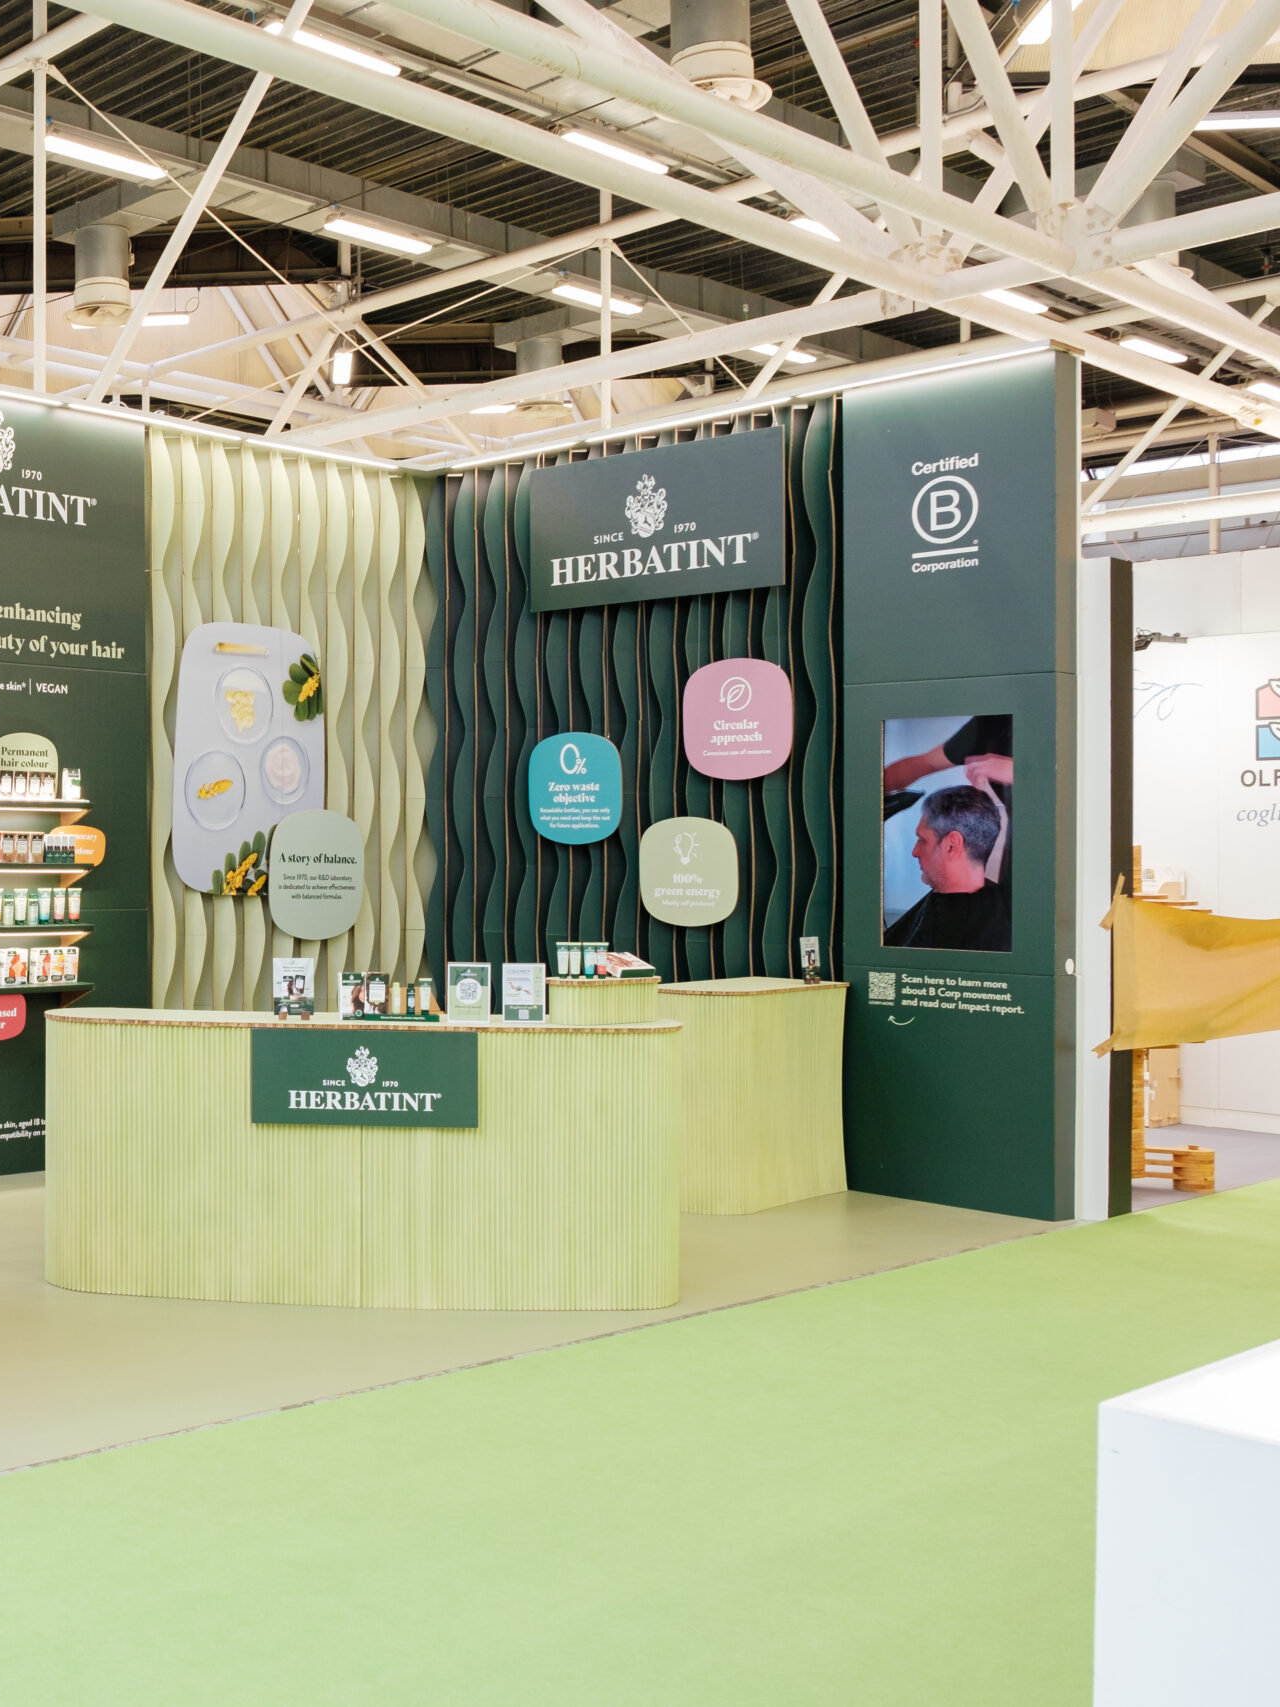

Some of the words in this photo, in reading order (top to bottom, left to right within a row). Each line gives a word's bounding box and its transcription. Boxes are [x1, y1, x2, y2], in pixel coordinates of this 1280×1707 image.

[911, 453, 979, 476] Certified
[21, 468, 42, 481] 1970
[930, 489, 962, 532] B
[593, 531, 624, 545] SINCE
[673, 521, 697, 534] 1970
[912, 557, 979, 573] Corporation
[28, 635, 48, 653] of
[50, 641, 89, 658] your
[91, 640, 125, 660] hair
[35, 682, 69, 694] VEGAN
[713, 719, 760, 730] Circular
[710, 731, 762, 746] approach
[1, 746, 48, 758] Permanent
[0, 758, 20, 767] hair
[20, 759, 48, 768] colour
[548, 782, 570, 792] Zero
[572, 782, 600, 792] waste
[553, 792, 596, 806] objective
[279, 852, 286, 863] A
[288, 854, 311, 866] story
[313, 852, 324, 864] of
[324, 853, 358, 864] balance.
[672, 873, 704, 884] 100%
[654, 888, 684, 898] green
[686, 888, 722, 900] energy
[901, 974, 923, 984] Scan
[924, 976, 945, 986] here
[946, 978, 956, 986] to
[958, 978, 982, 988] learn
[983, 982, 1008, 990] more
[901, 986, 927, 996] about
[928, 987, 936, 996] B
[937, 987, 961, 1000] Corp
[962, 992, 1012, 1002] movement
[901, 998, 918, 1006] and
[919, 999, 939, 1008] read
[940, 1002, 956, 1010] our
[958, 1001, 990, 1013] Impact
[992, 1005, 1025, 1016] report.
[322, 1079, 346, 1087] SINCE
[382, 1080, 399, 1088] 1970
[4, 1120, 18, 1128] skin,
[18, 1118, 32, 1129] aged
